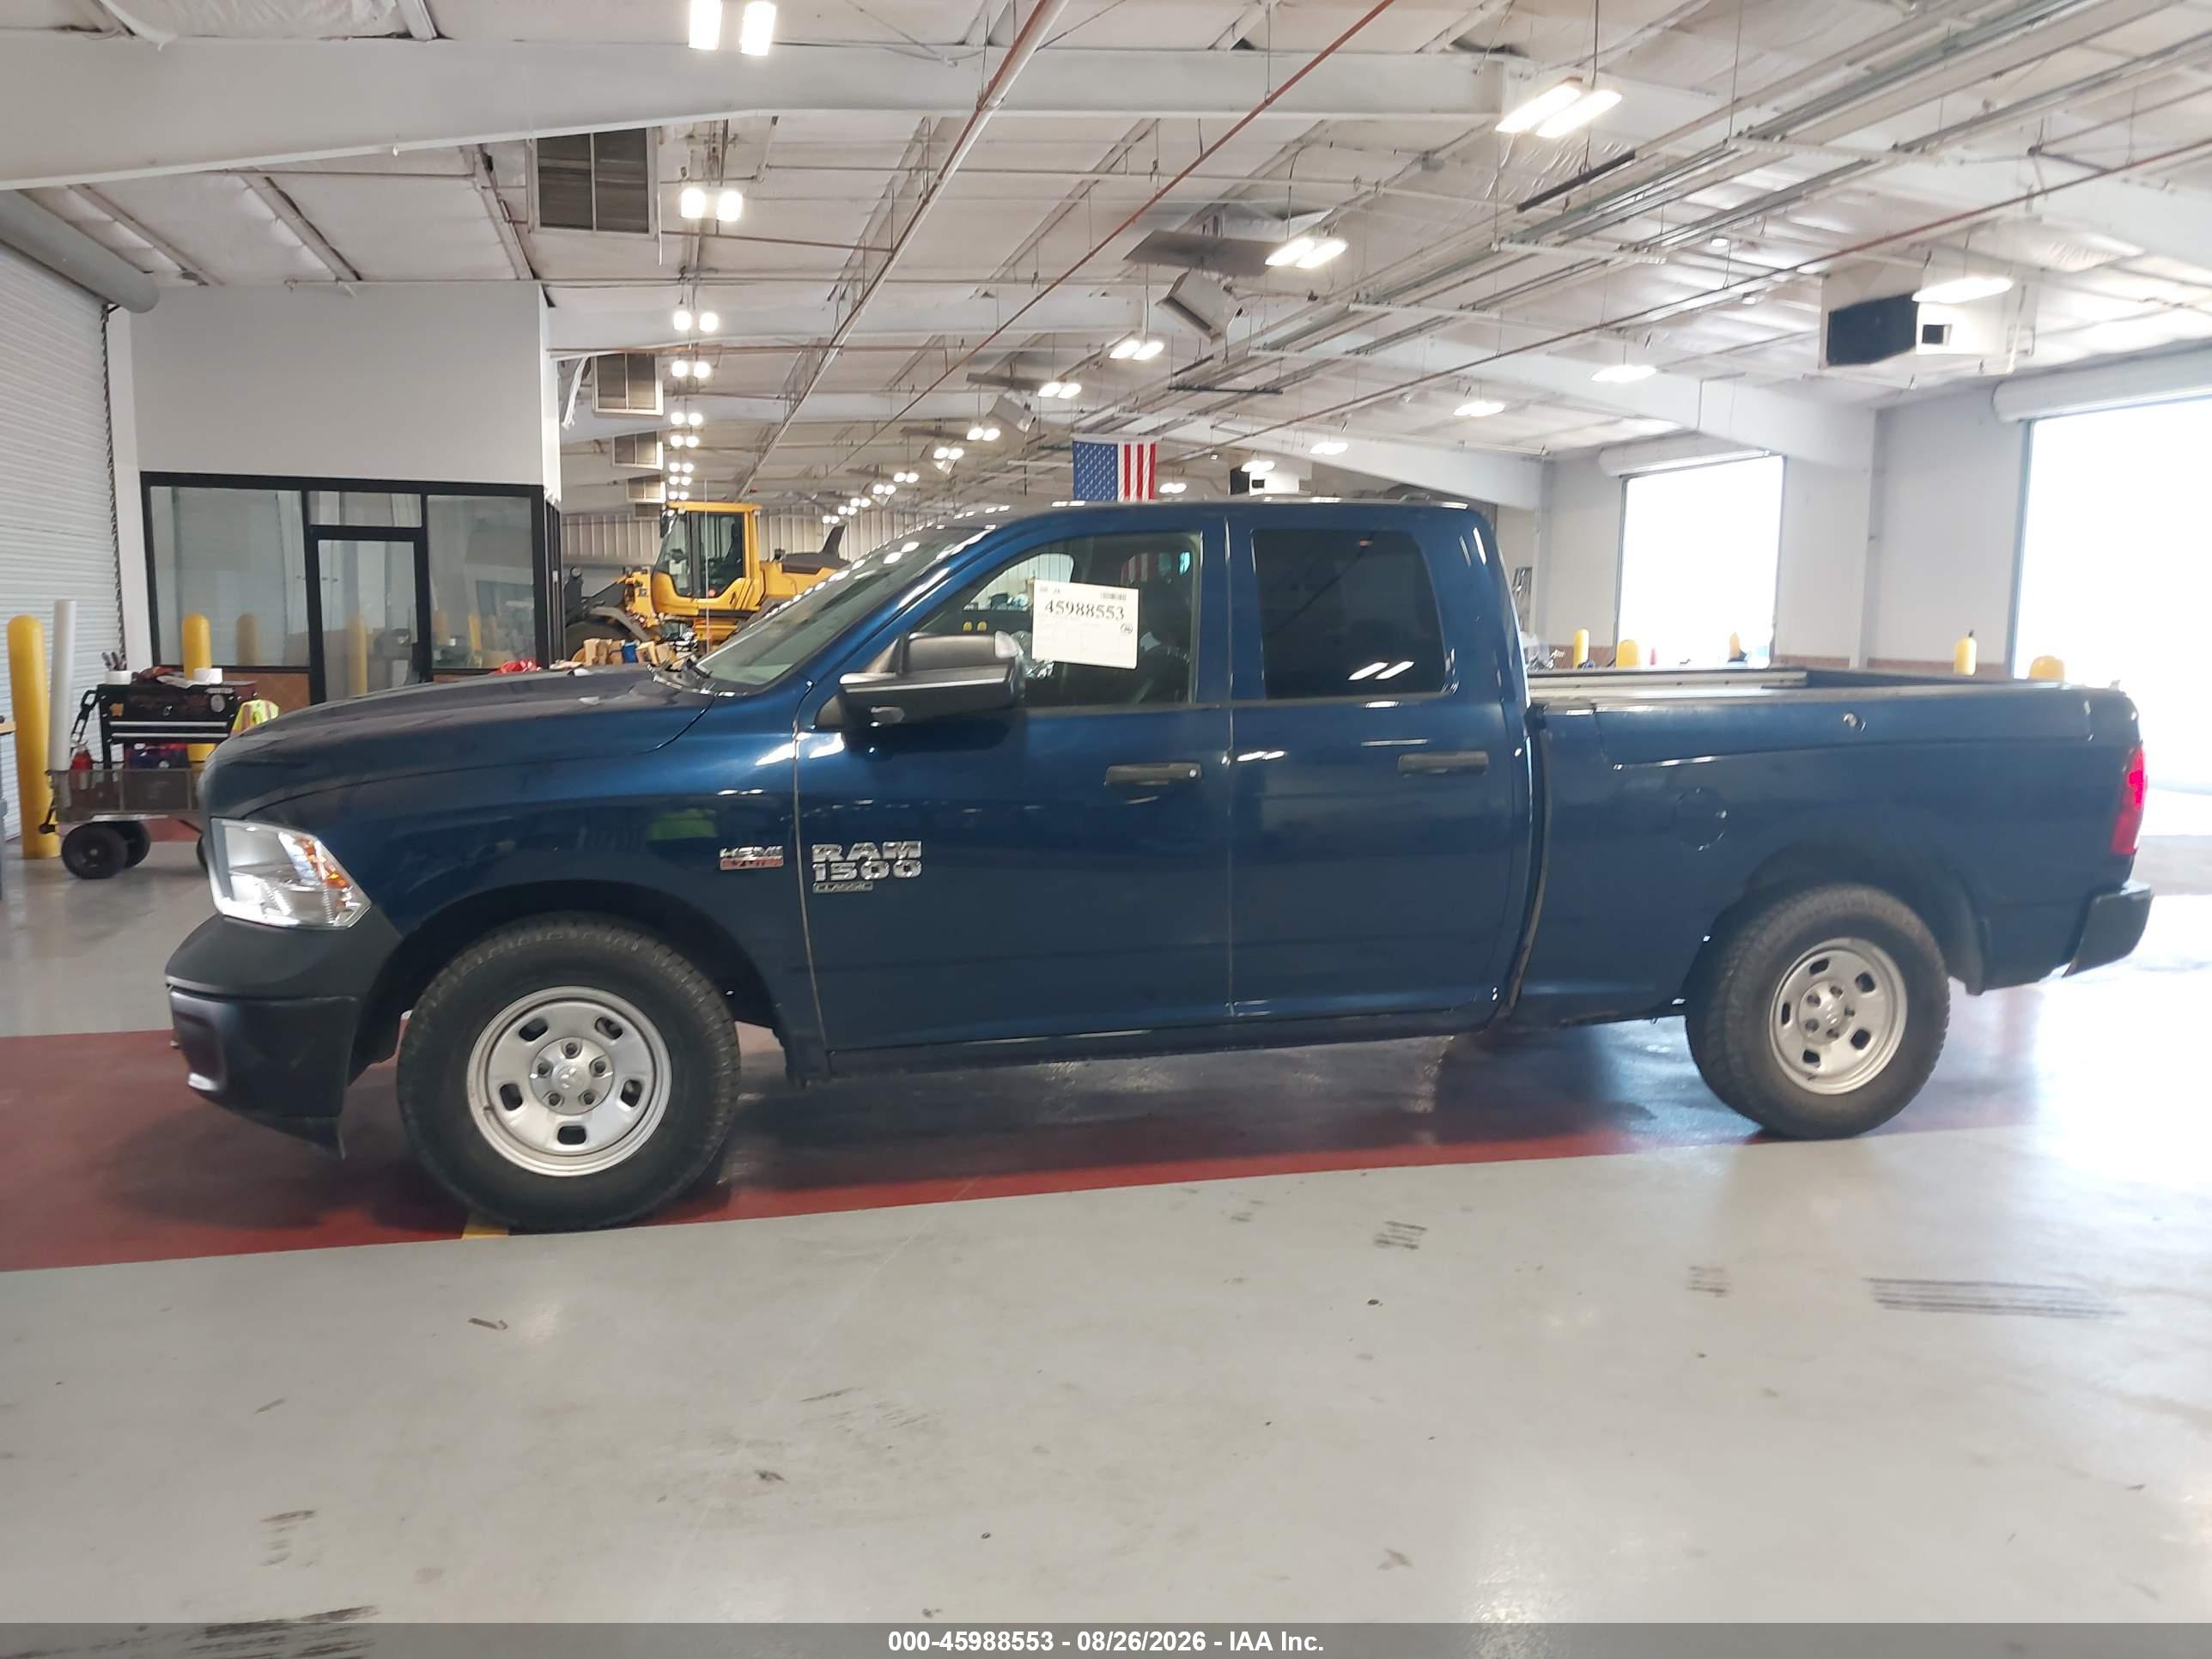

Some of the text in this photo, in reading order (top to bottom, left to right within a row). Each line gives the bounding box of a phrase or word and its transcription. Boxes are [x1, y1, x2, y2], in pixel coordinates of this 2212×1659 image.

[1044, 599, 1125, 621] 45988553
[811, 841, 922, 862] RAM
[812, 860, 922, 881] 1500
